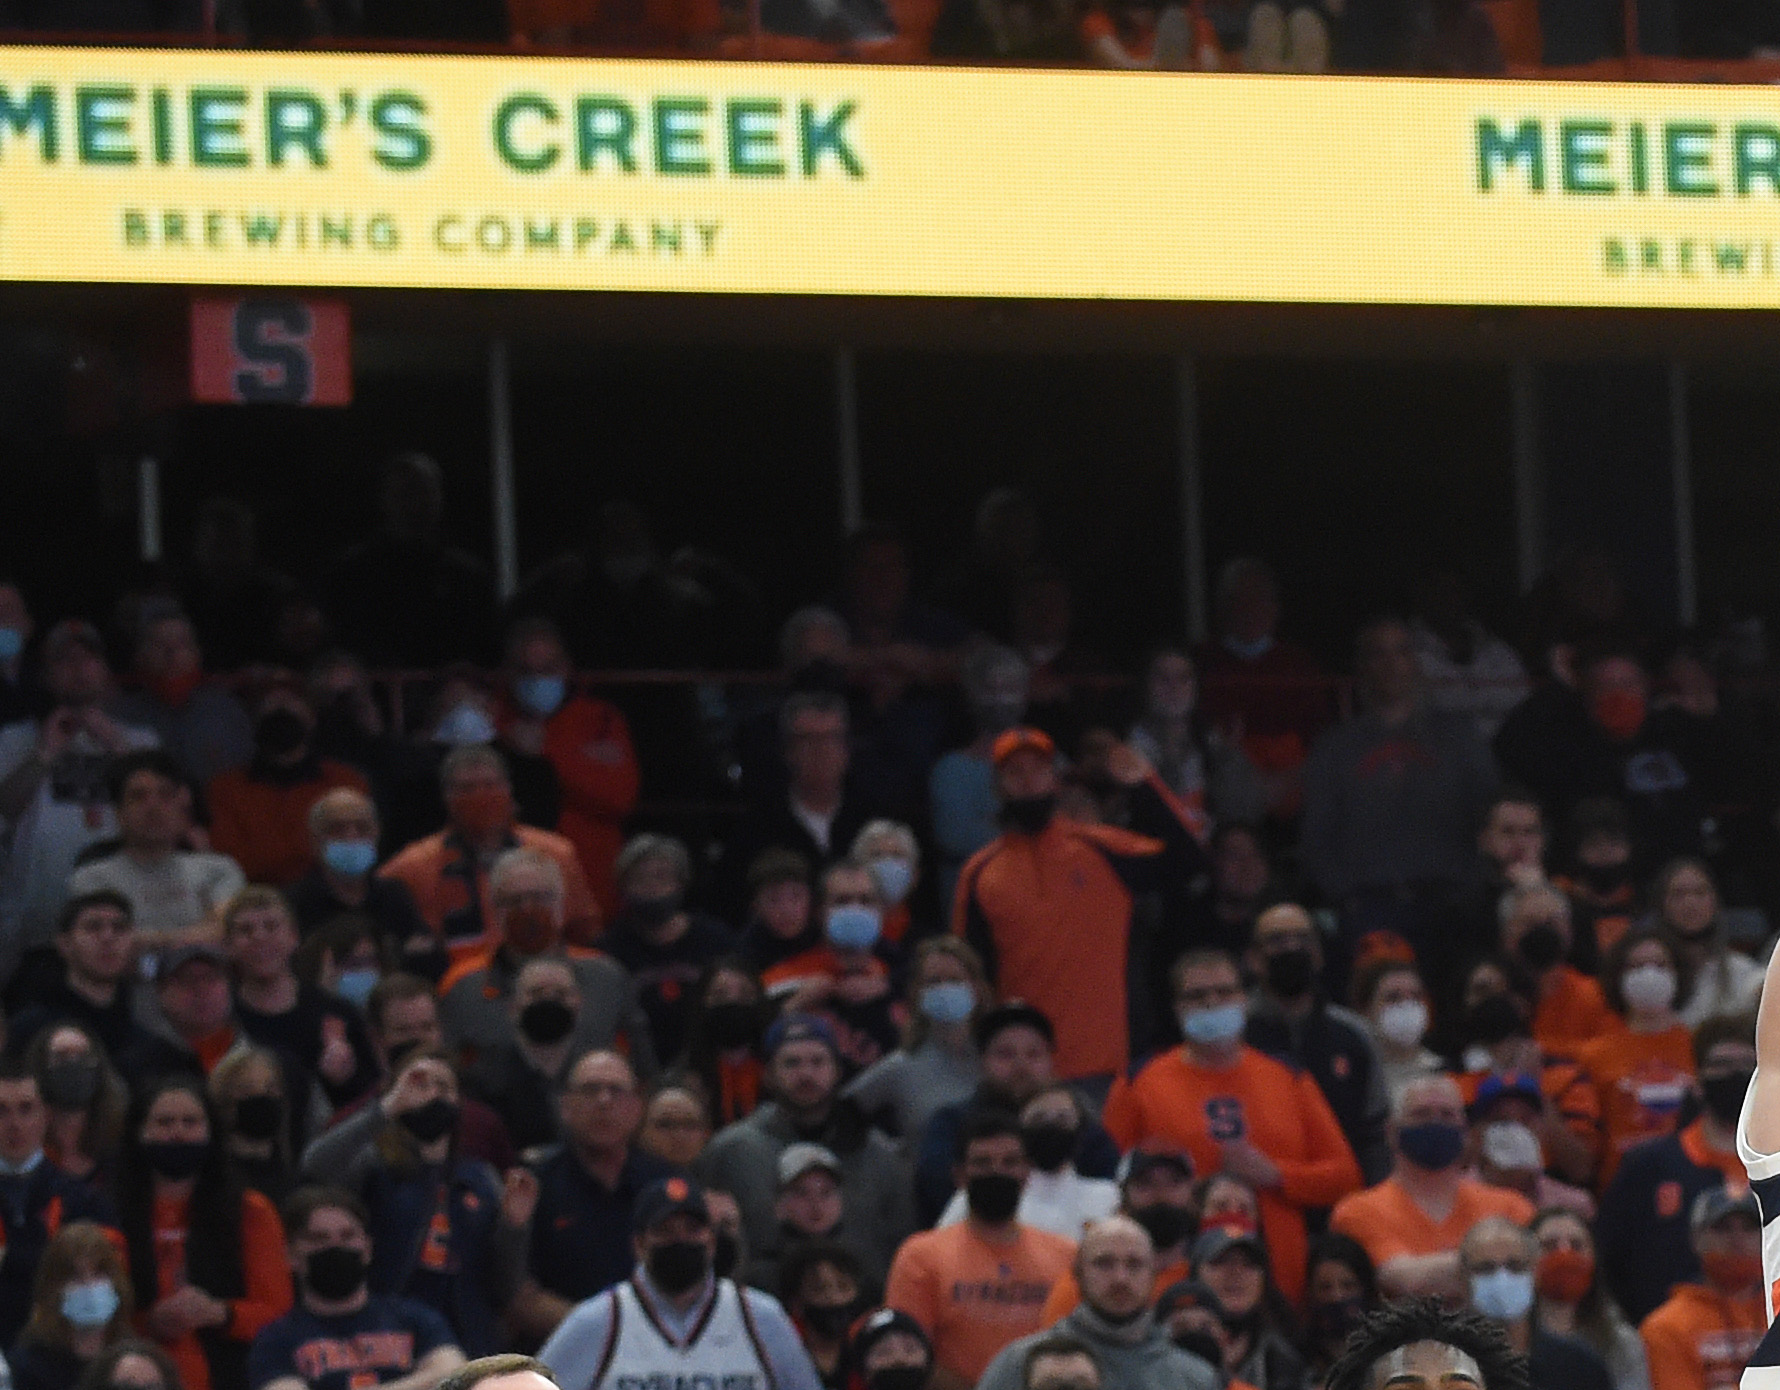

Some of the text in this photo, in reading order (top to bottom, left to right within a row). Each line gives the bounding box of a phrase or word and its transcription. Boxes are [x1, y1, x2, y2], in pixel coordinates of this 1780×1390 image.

[0, 84, 864, 179] MEIER'S CREEK
[123, 208, 723, 257] BREWING COMPANY
[231, 297, 313, 403] S
